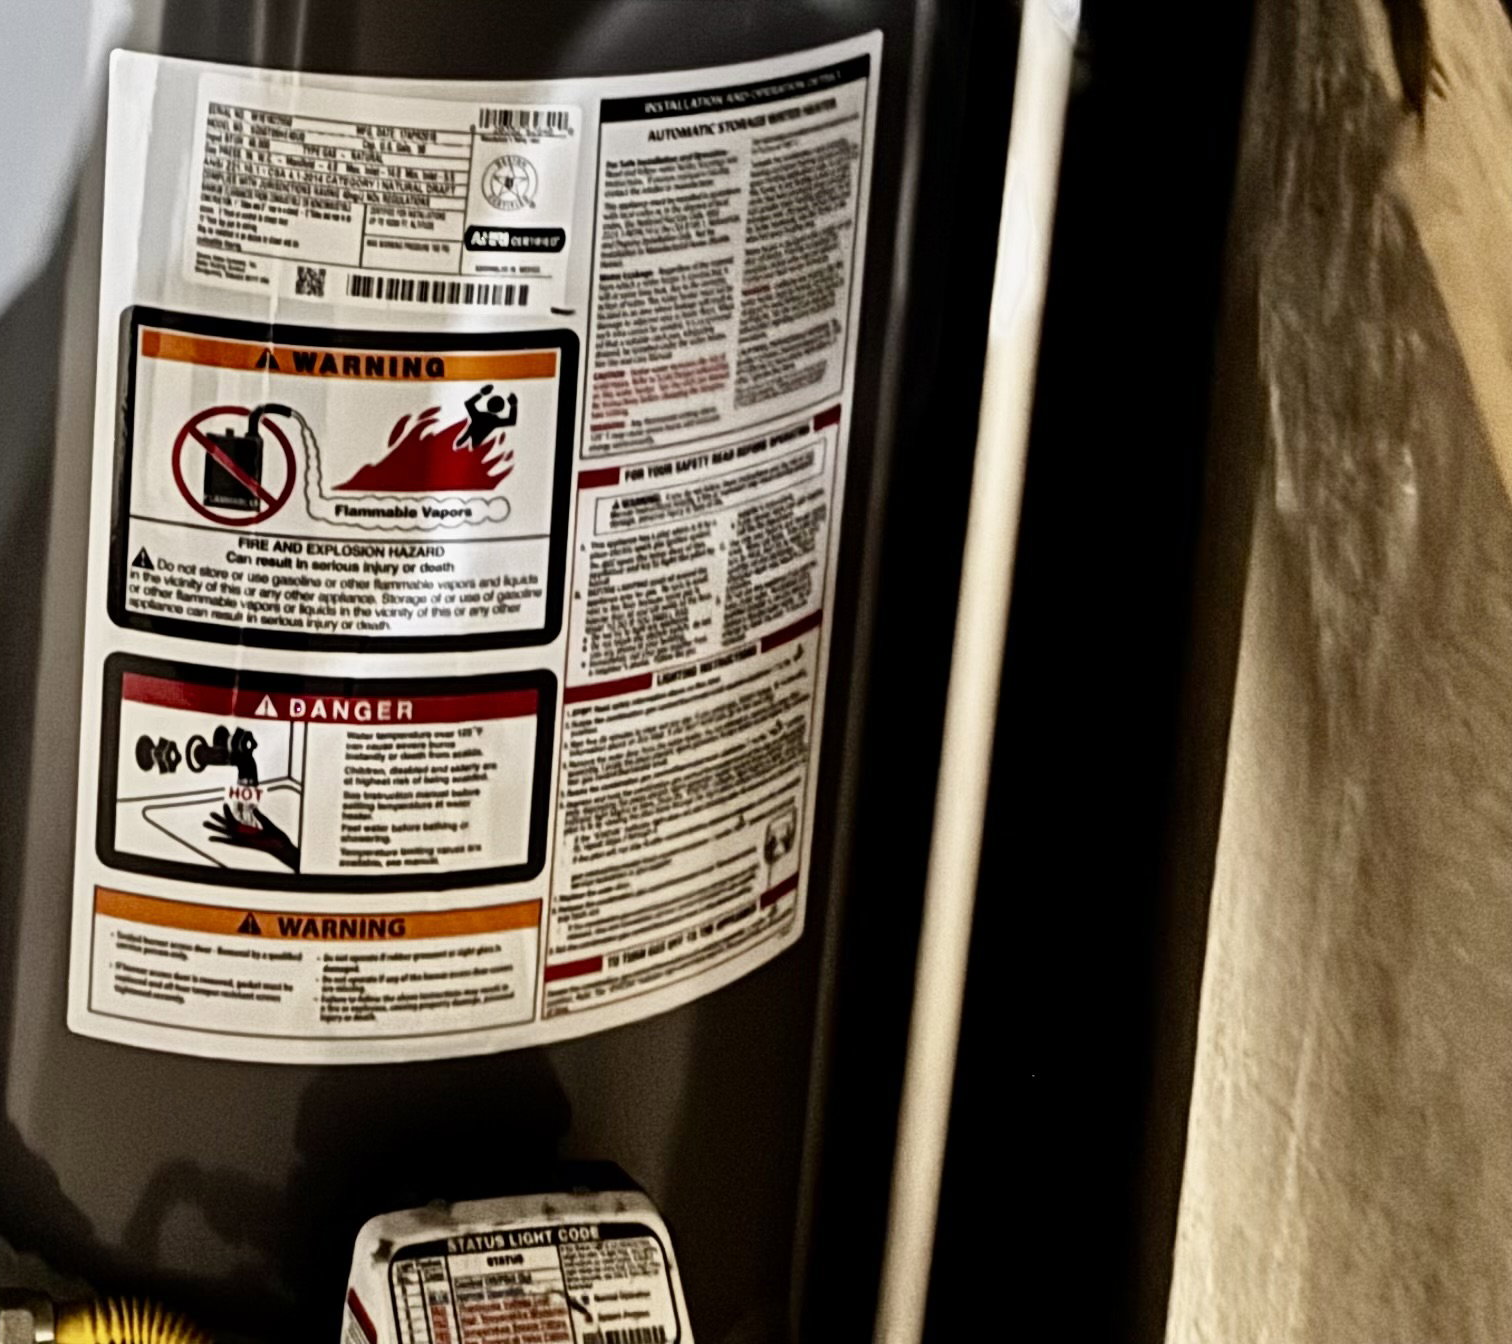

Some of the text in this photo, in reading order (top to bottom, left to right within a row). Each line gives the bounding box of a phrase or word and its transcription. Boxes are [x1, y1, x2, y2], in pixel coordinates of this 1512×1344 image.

[292, 350, 446, 379] WARNING
[334, 504, 473, 523] Flammable Vapors
[237, 536, 445, 559] FIRE AND EXPLOSION HAZARD
[225, 550, 455, 576] Can result in serious injury or death
[288, 699, 415, 722] DANGER
[228, 786, 264, 801] HOT
[277, 917, 406, 940] WARNING
[447, 1225, 599, 1252] STATUS LIGHT CODE
[486, 1253, 524, 1268] STATUS
